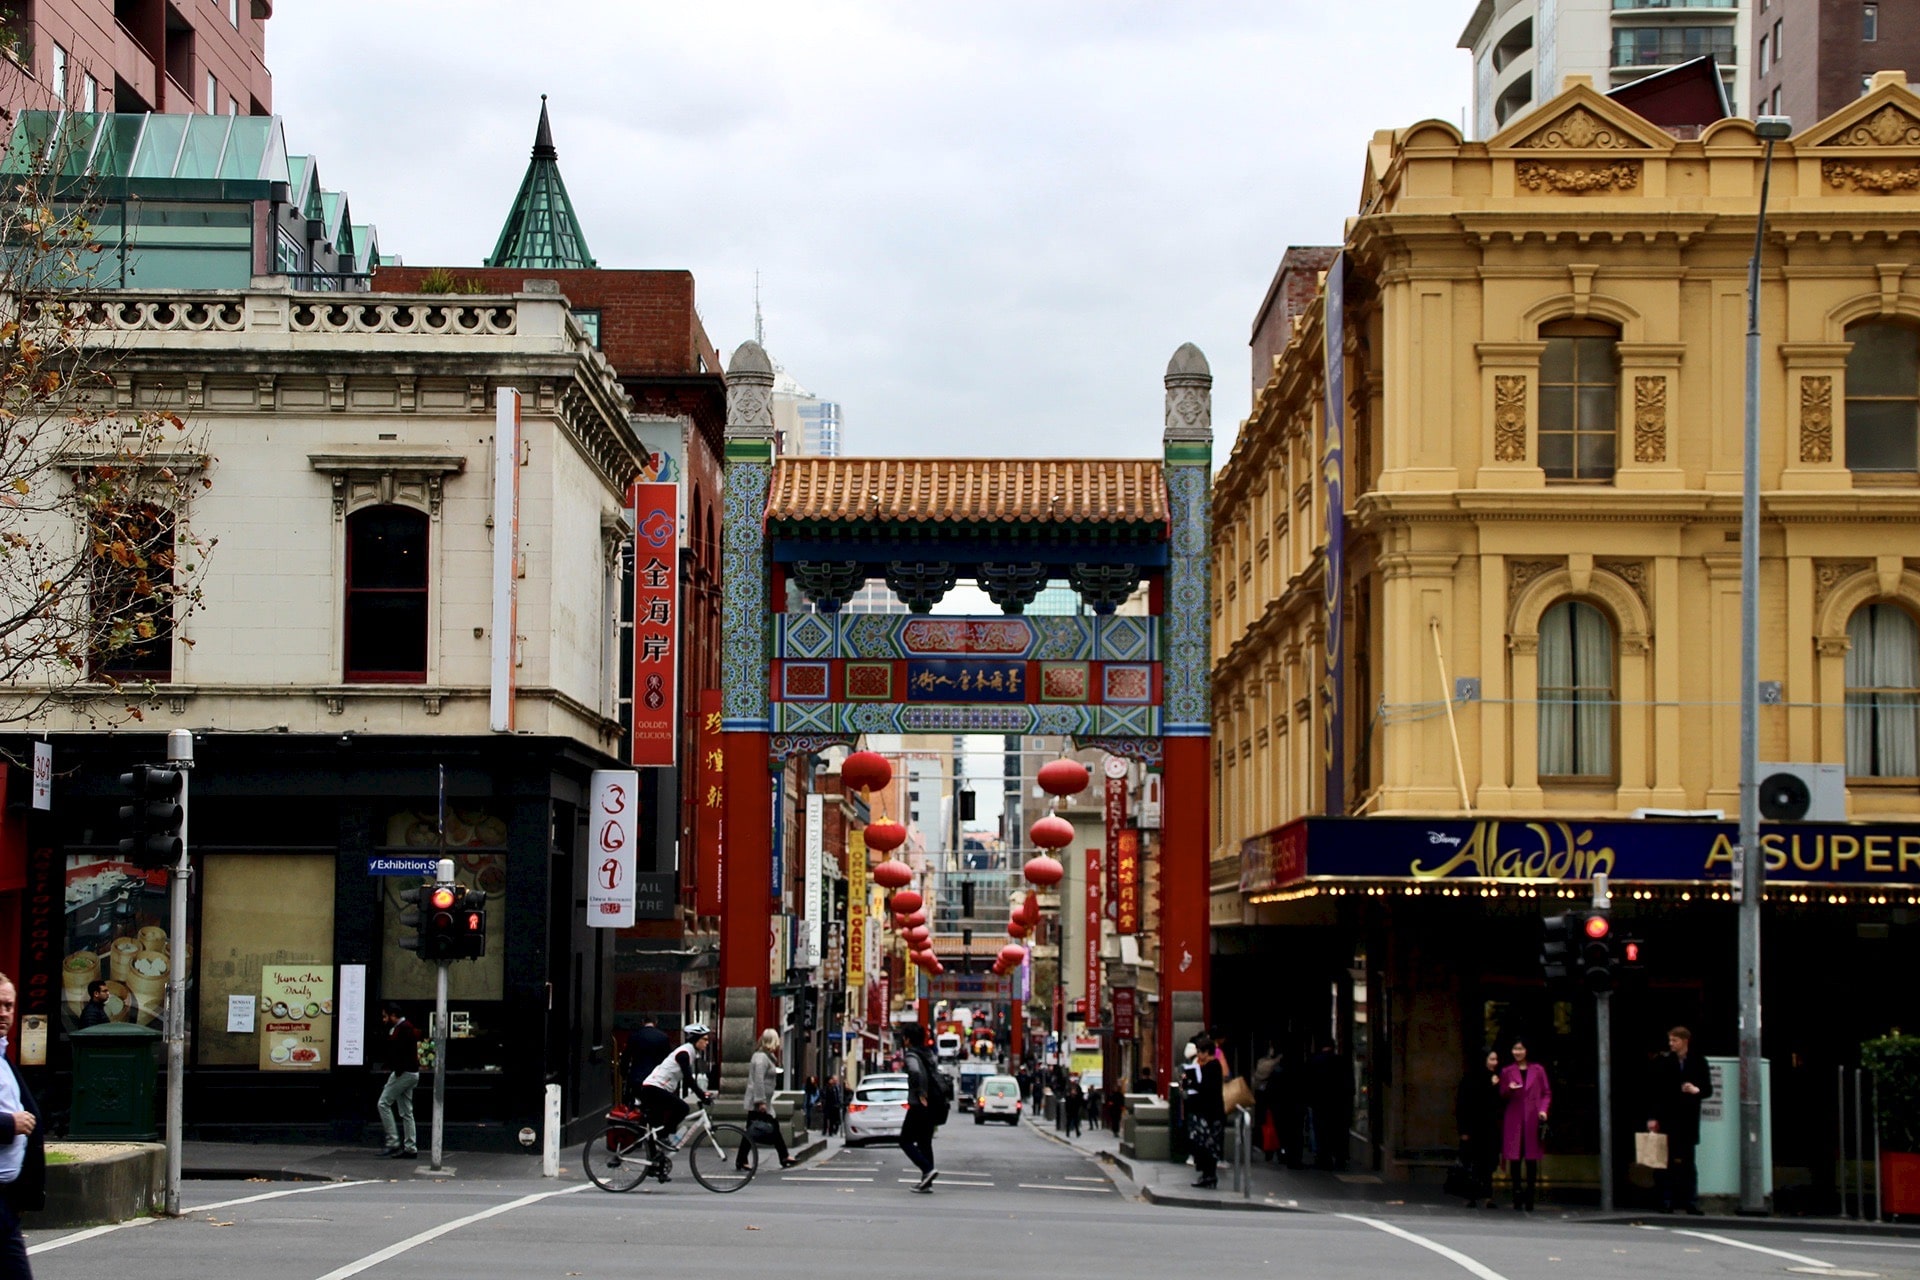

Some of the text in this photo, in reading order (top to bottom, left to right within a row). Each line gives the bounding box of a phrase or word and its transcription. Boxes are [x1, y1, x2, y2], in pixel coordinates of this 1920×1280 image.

[640, 557, 671, 663] 金海岸
[638, 721, 668, 729] GOLDEN
[635, 732, 672, 740] DELICIOUS
[810, 803, 819, 824] THE
[598, 784, 626, 890] 369
[1427, 831, 1461, 847] Disney
[809, 829, 819, 879] DESSERT
[1410, 821, 1615, 879] Aladdin
[1704, 833, 1734, 870] A
[377, 860, 427, 870] Exhibition
[851, 852, 863, 973] ORCHIS GARDEN
[273, 972, 324, 985] Yum Cha
[1089, 969, 1096, 981] OF
[283, 985, 312, 999] Daily
